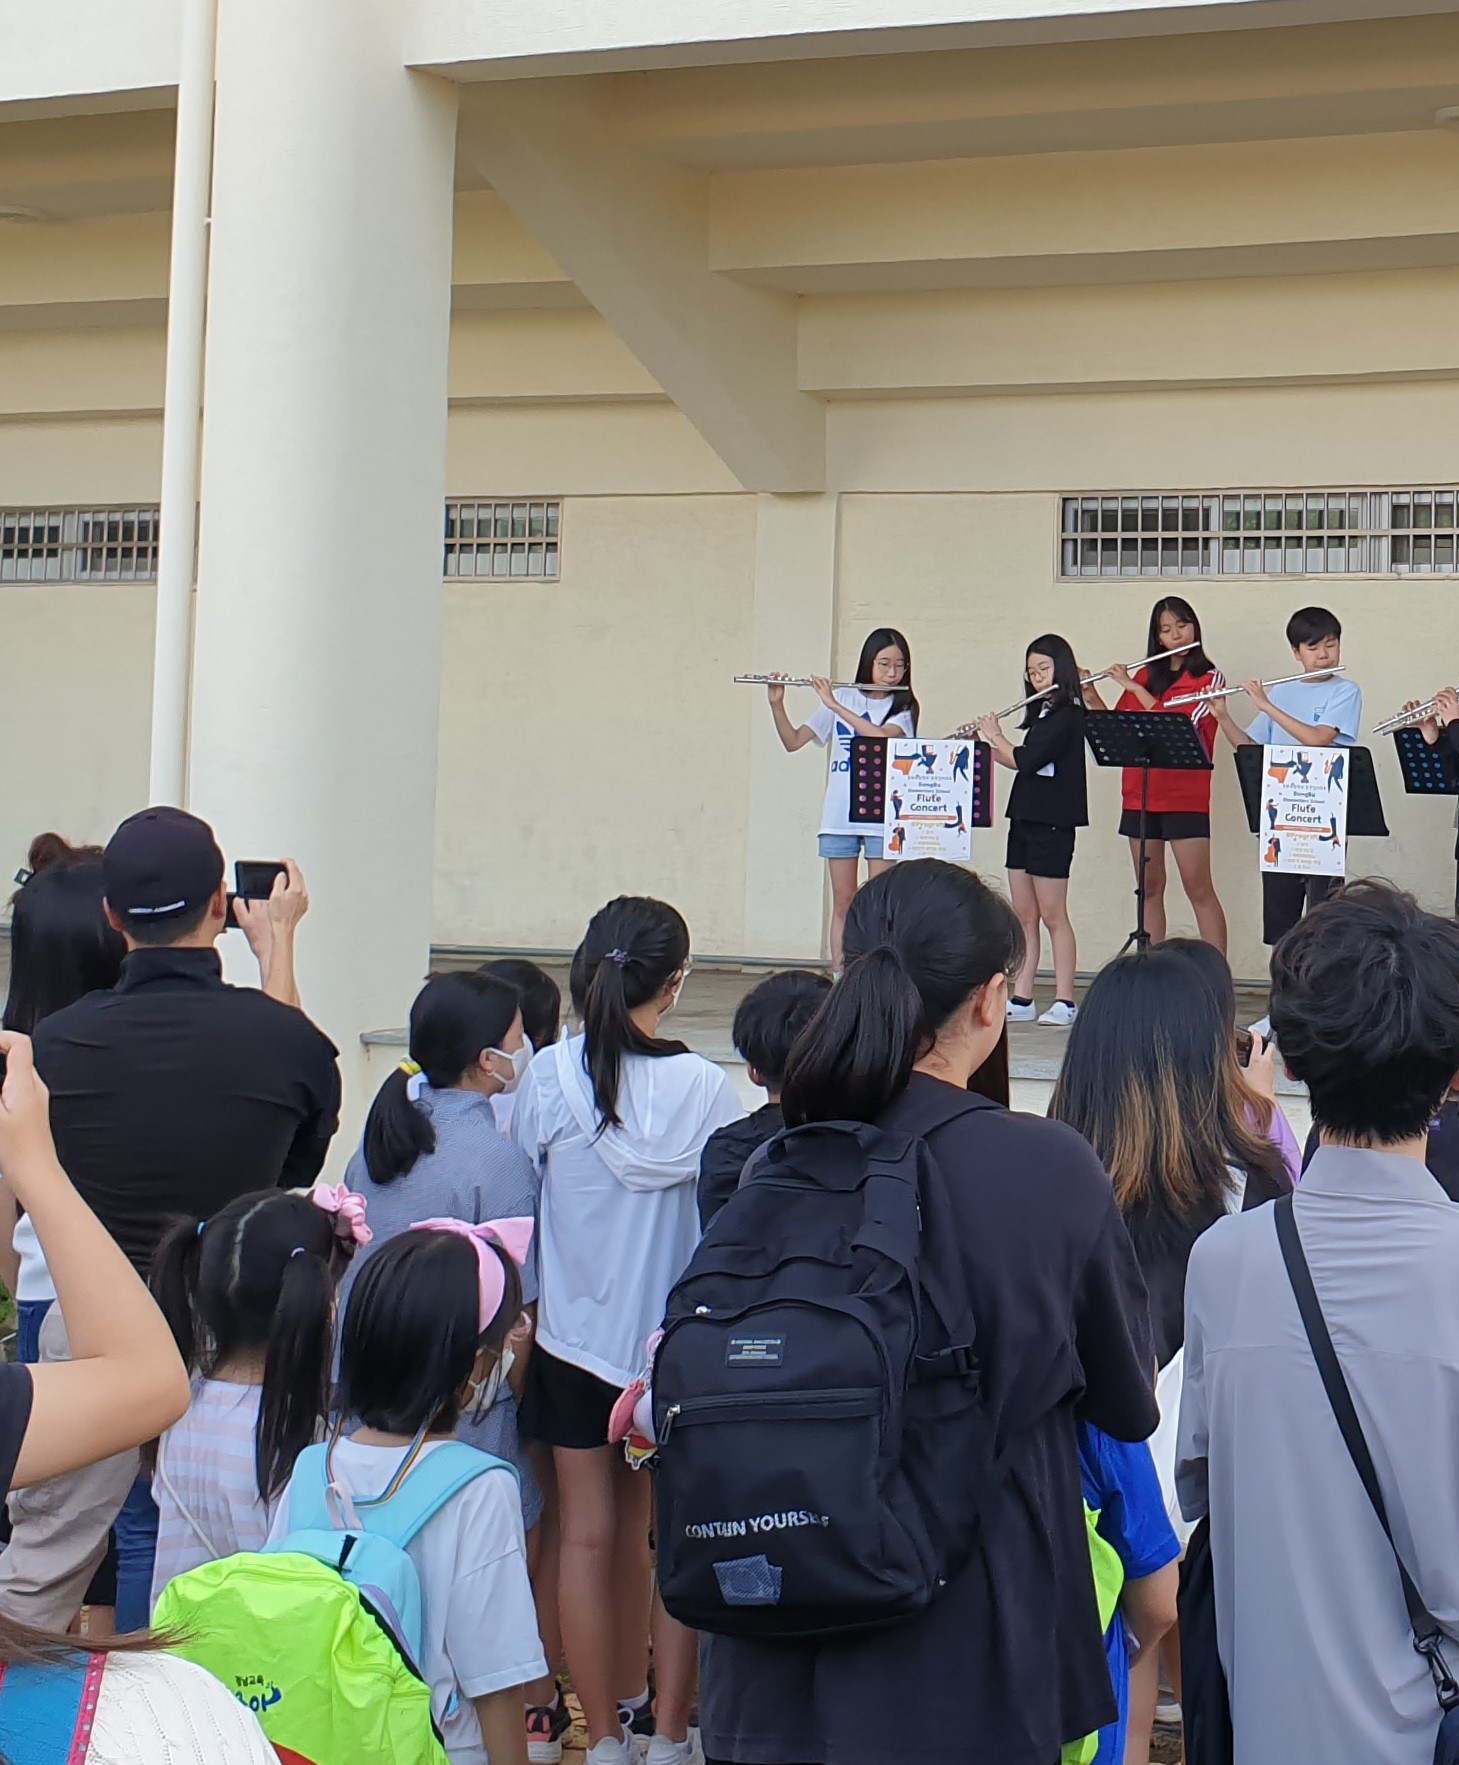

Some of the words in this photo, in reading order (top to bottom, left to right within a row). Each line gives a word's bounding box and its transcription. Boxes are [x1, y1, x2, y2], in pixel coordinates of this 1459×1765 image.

[917, 793, 942, 803] Flute
[910, 803, 947, 813] Concert
[1291, 804, 1316, 814] Flute
[1285, 813, 1323, 824] Concert
